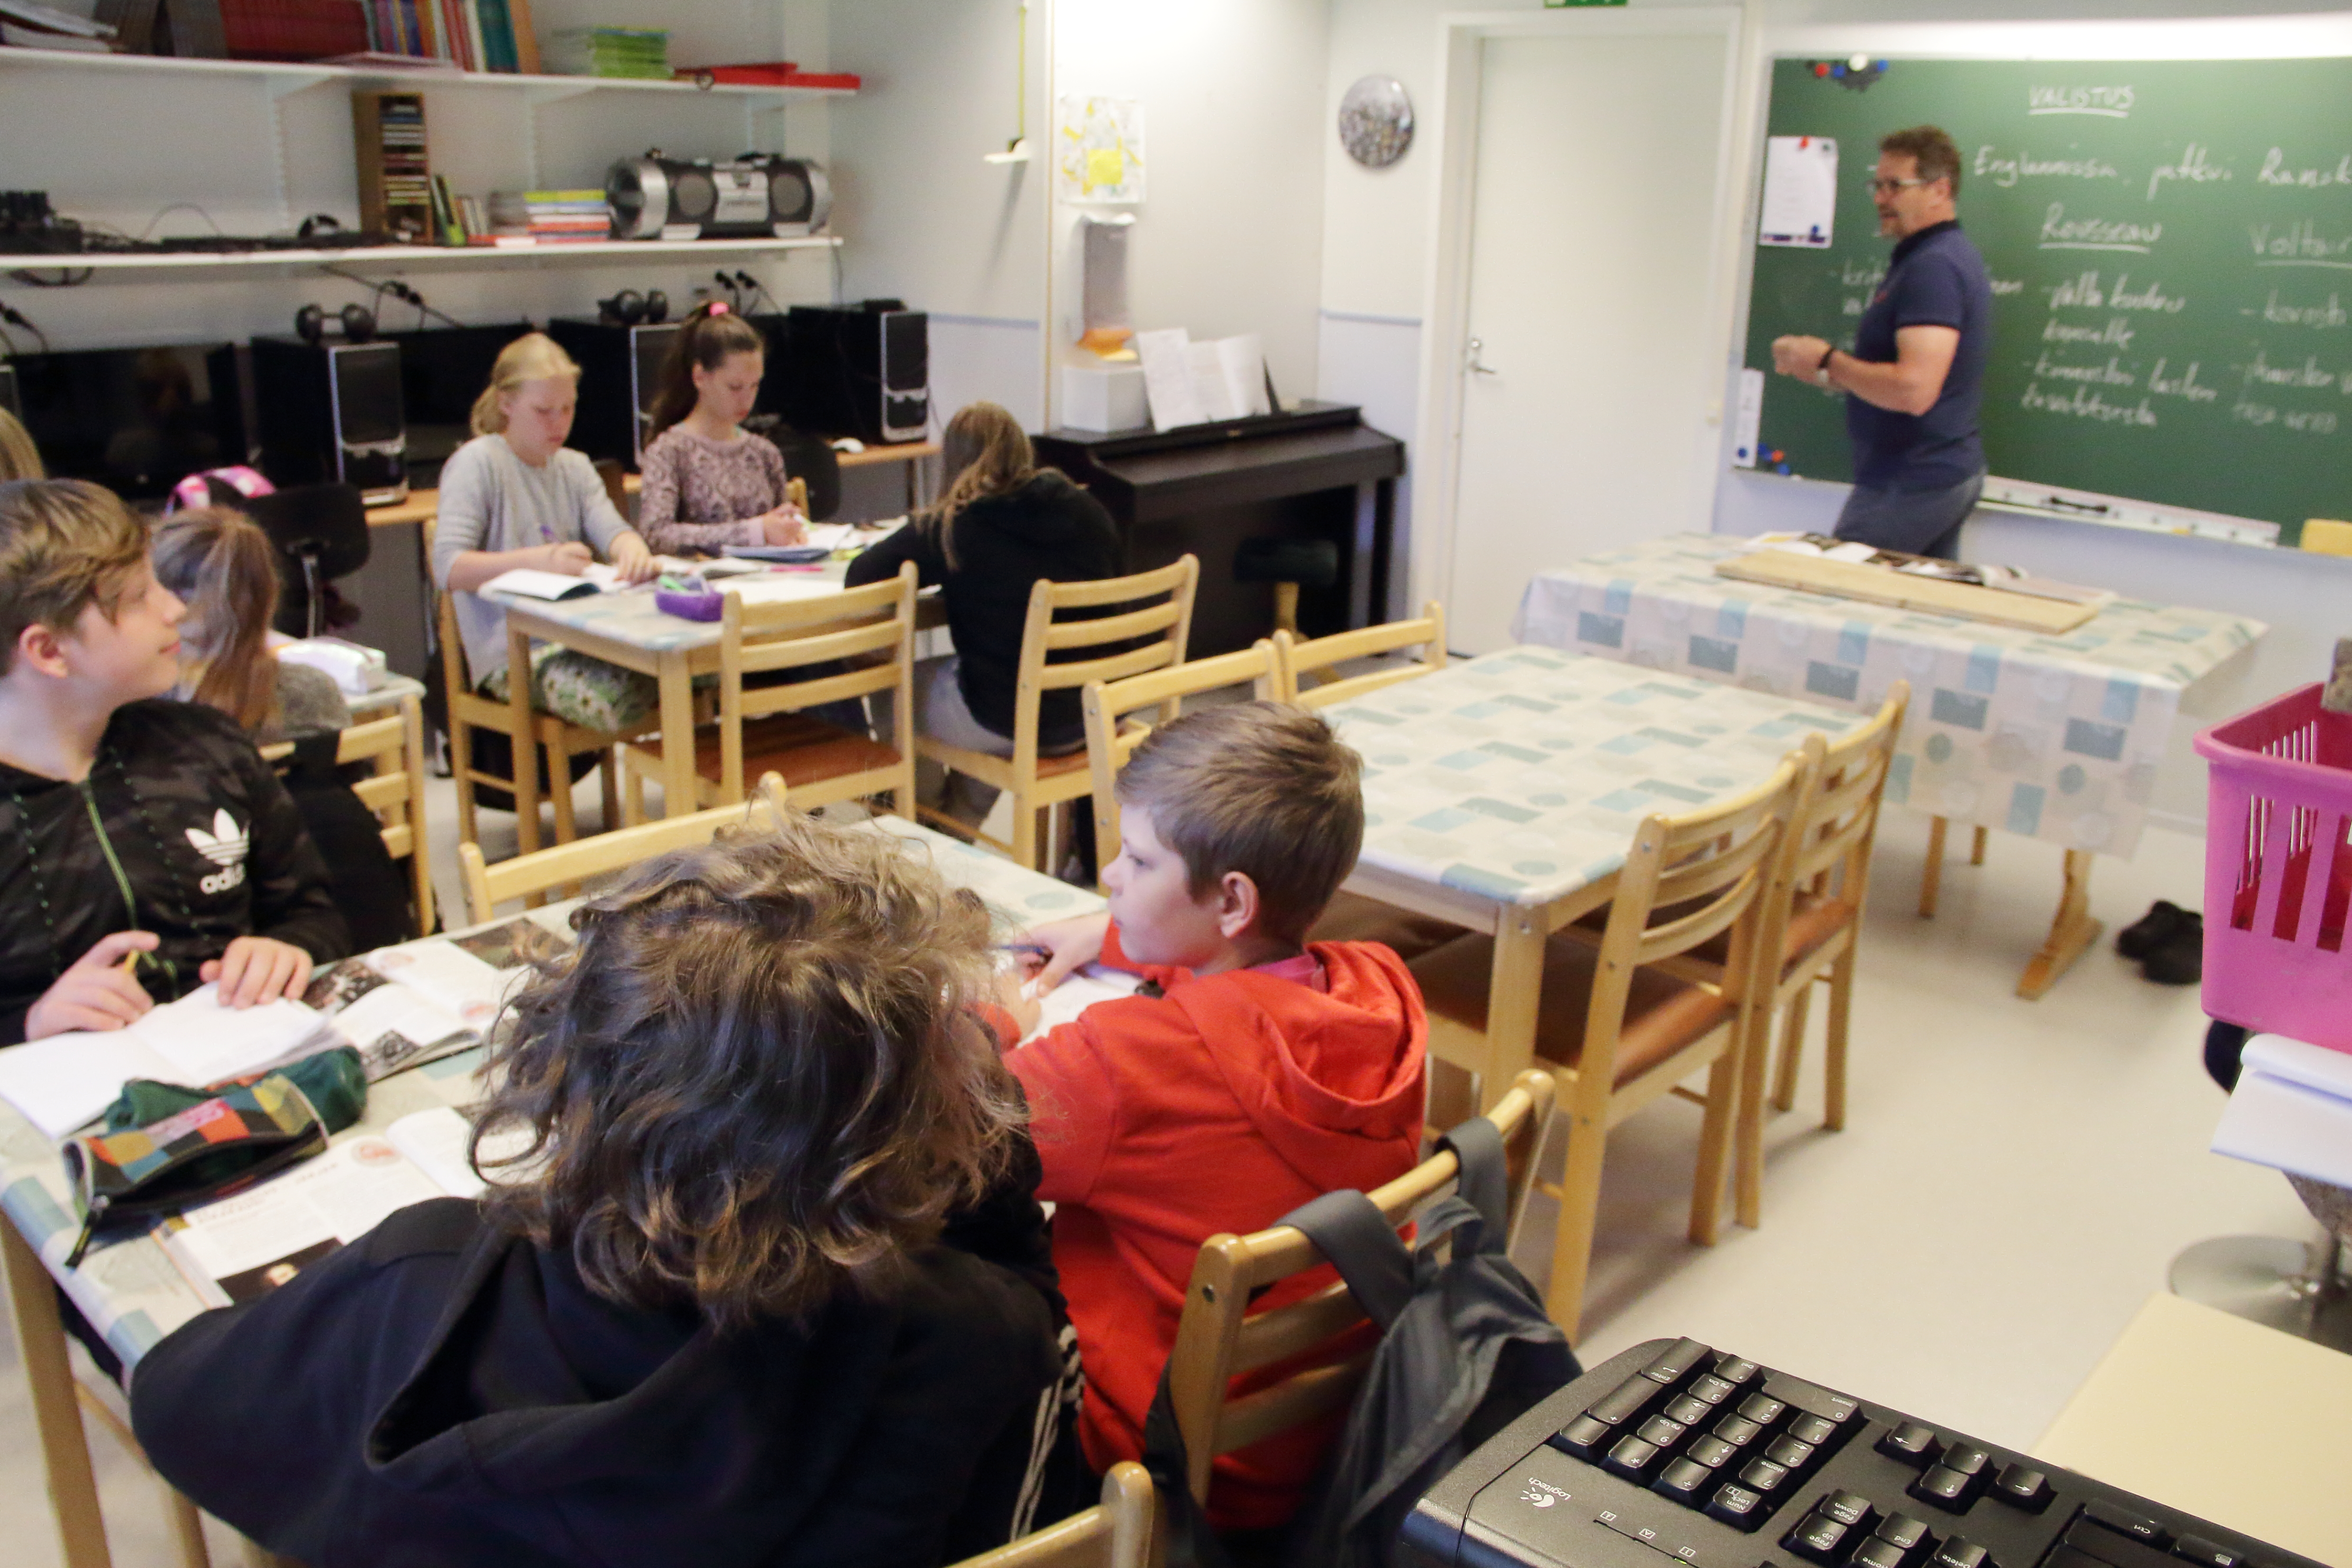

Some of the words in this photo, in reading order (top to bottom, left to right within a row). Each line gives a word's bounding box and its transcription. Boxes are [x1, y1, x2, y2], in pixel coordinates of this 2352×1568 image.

[2029, 85, 2135, 110] VALISTUS
[2040, 202, 2163, 242] Rousseau
[1650, 1372, 1671, 1381] Enter
[1708, 1378, 1719, 1386] Dn
[1831, 1396, 1854, 1408] Insert
[1659, 1419, 1670, 1428] Up
[1815, 1420, 1831, 1429] End
[1761, 1460, 1785, 1473] Home
[1528, 1477, 1572, 1501] Logitech
[1726, 1500, 1745, 1511] Num
[1731, 1495, 1750, 1505] Lock
[1834, 1502, 1858, 1515] Down
[1833, 1509, 1855, 1521] Page
[2133, 1524, 2151, 1534] Ctrl
[1809, 1534, 1829, 1547] Page
[1821, 1532, 1834, 1541] Up
[1894, 1535, 1911, 1544] End
[1942, 1554, 1971, 1568] Delete
